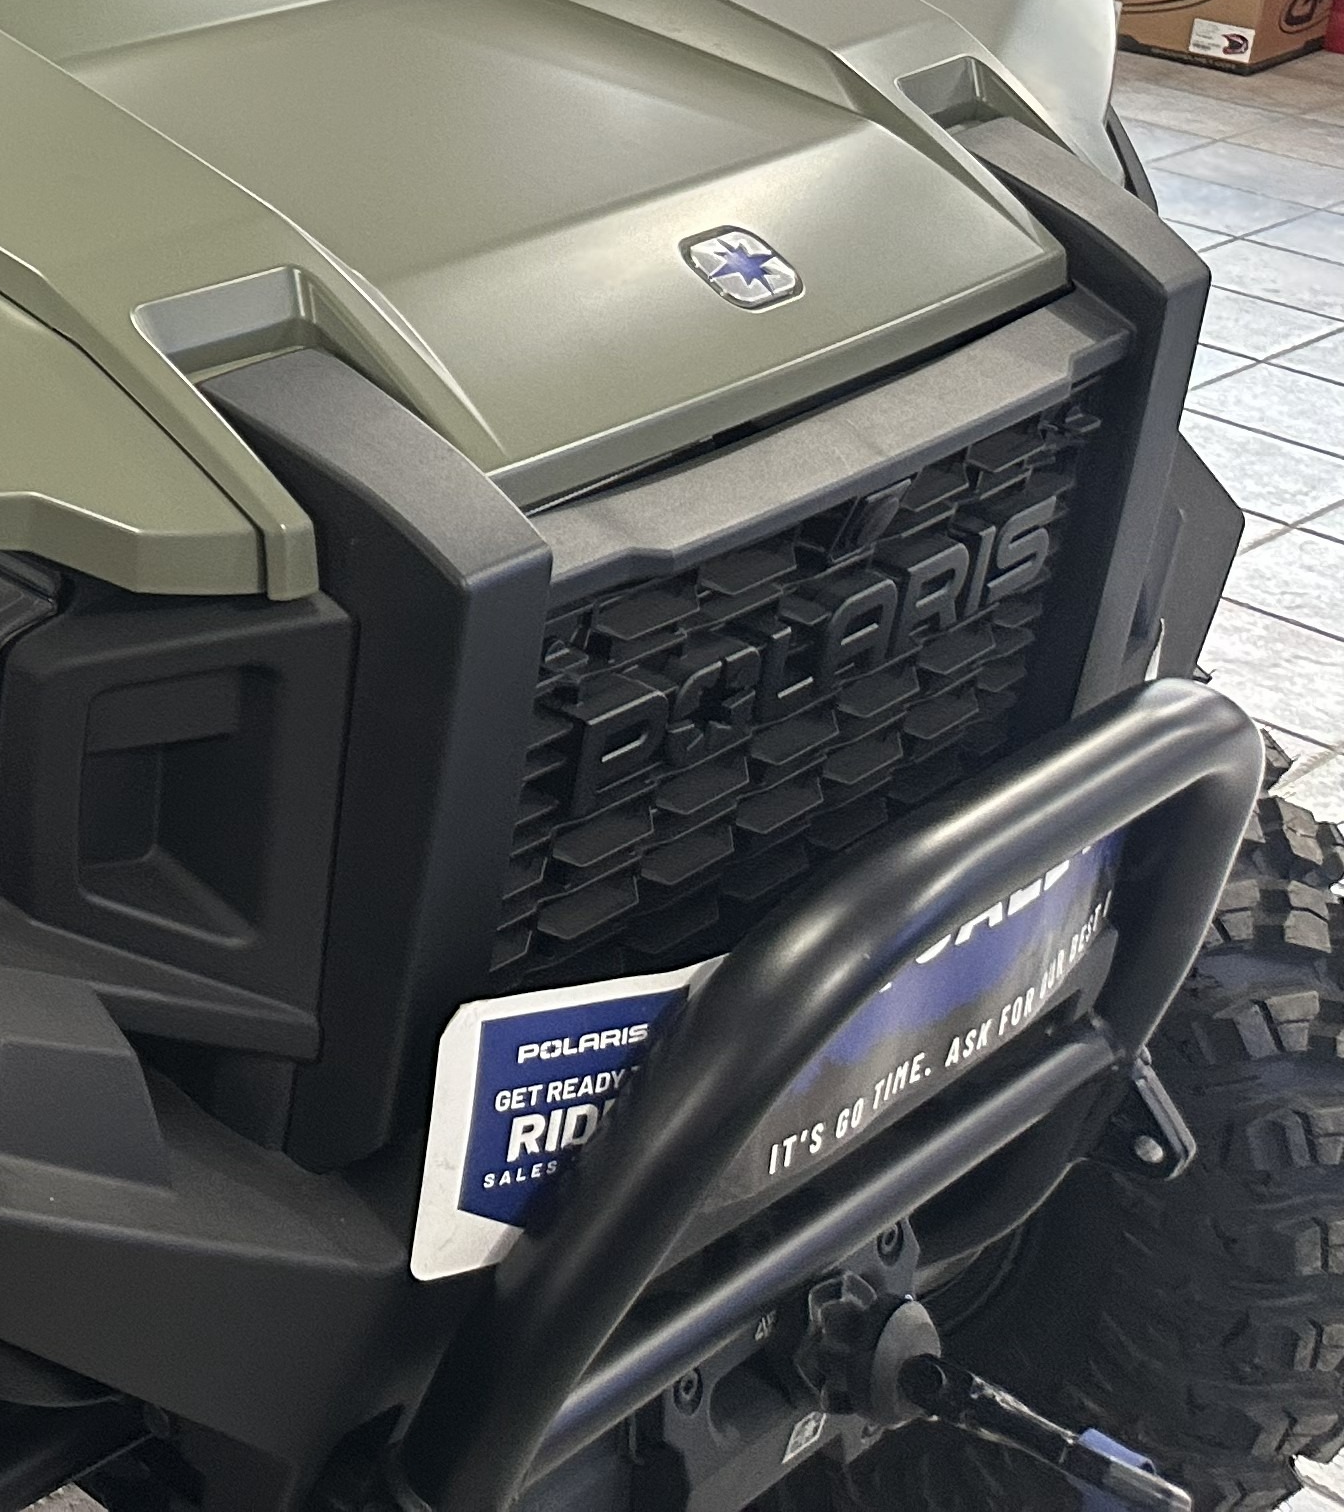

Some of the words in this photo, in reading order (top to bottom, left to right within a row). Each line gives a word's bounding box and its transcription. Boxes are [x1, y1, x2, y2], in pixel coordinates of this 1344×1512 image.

[574, 495, 1058, 820] POLARIS
[517, 1022, 649, 1064] POLARIS
[768, 1122, 825, 1175] IT'S
[836, 1097, 864, 1139] GO
[872, 1051, 932, 1110] TIME.
[945, 1018, 994, 1068] ASK
[998, 986, 1036, 1036] FOR
[1069, 901, 1102, 963] BEST
[495, 1084, 544, 1112] GET
[546, 1068, 626, 1104] READY
[507, 1099, 616, 1163] RID
[483, 1159, 558, 1189] SALES
